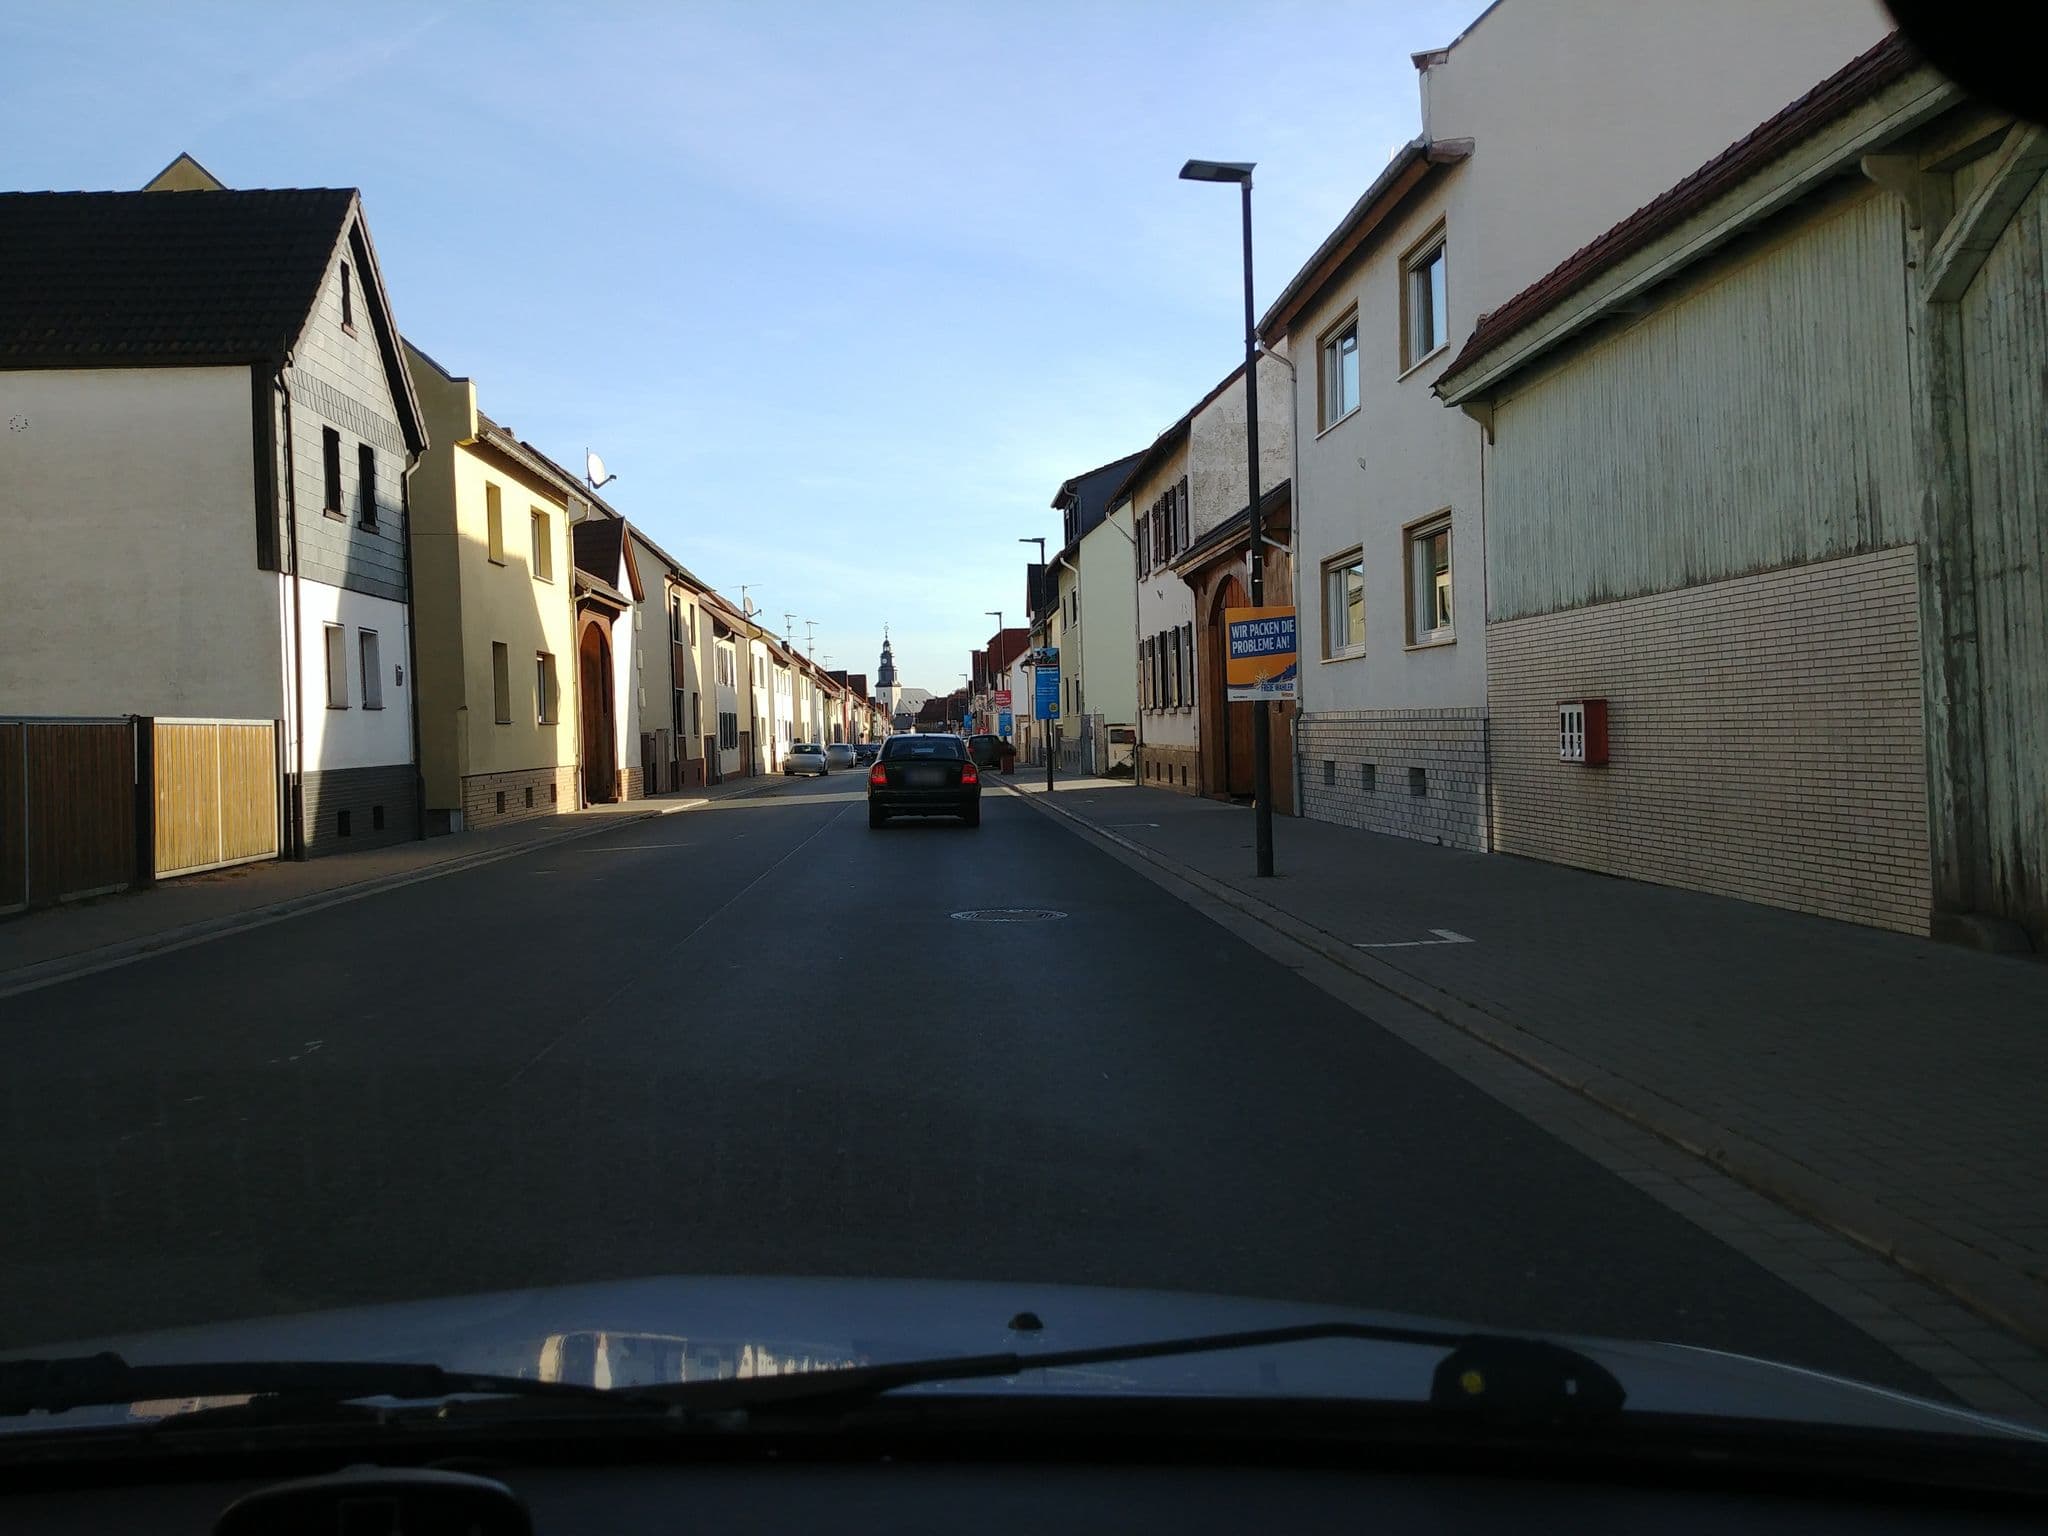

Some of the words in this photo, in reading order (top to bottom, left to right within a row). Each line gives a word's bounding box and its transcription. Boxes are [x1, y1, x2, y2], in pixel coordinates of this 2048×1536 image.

[1231, 625, 1247, 639] WIR
[1250, 622, 1279, 637] PACKEN
[1282, 620, 1294, 633] DIE
[1232, 637, 1274, 654] PROBLEME
[1276, 636, 1290, 649] AN!
